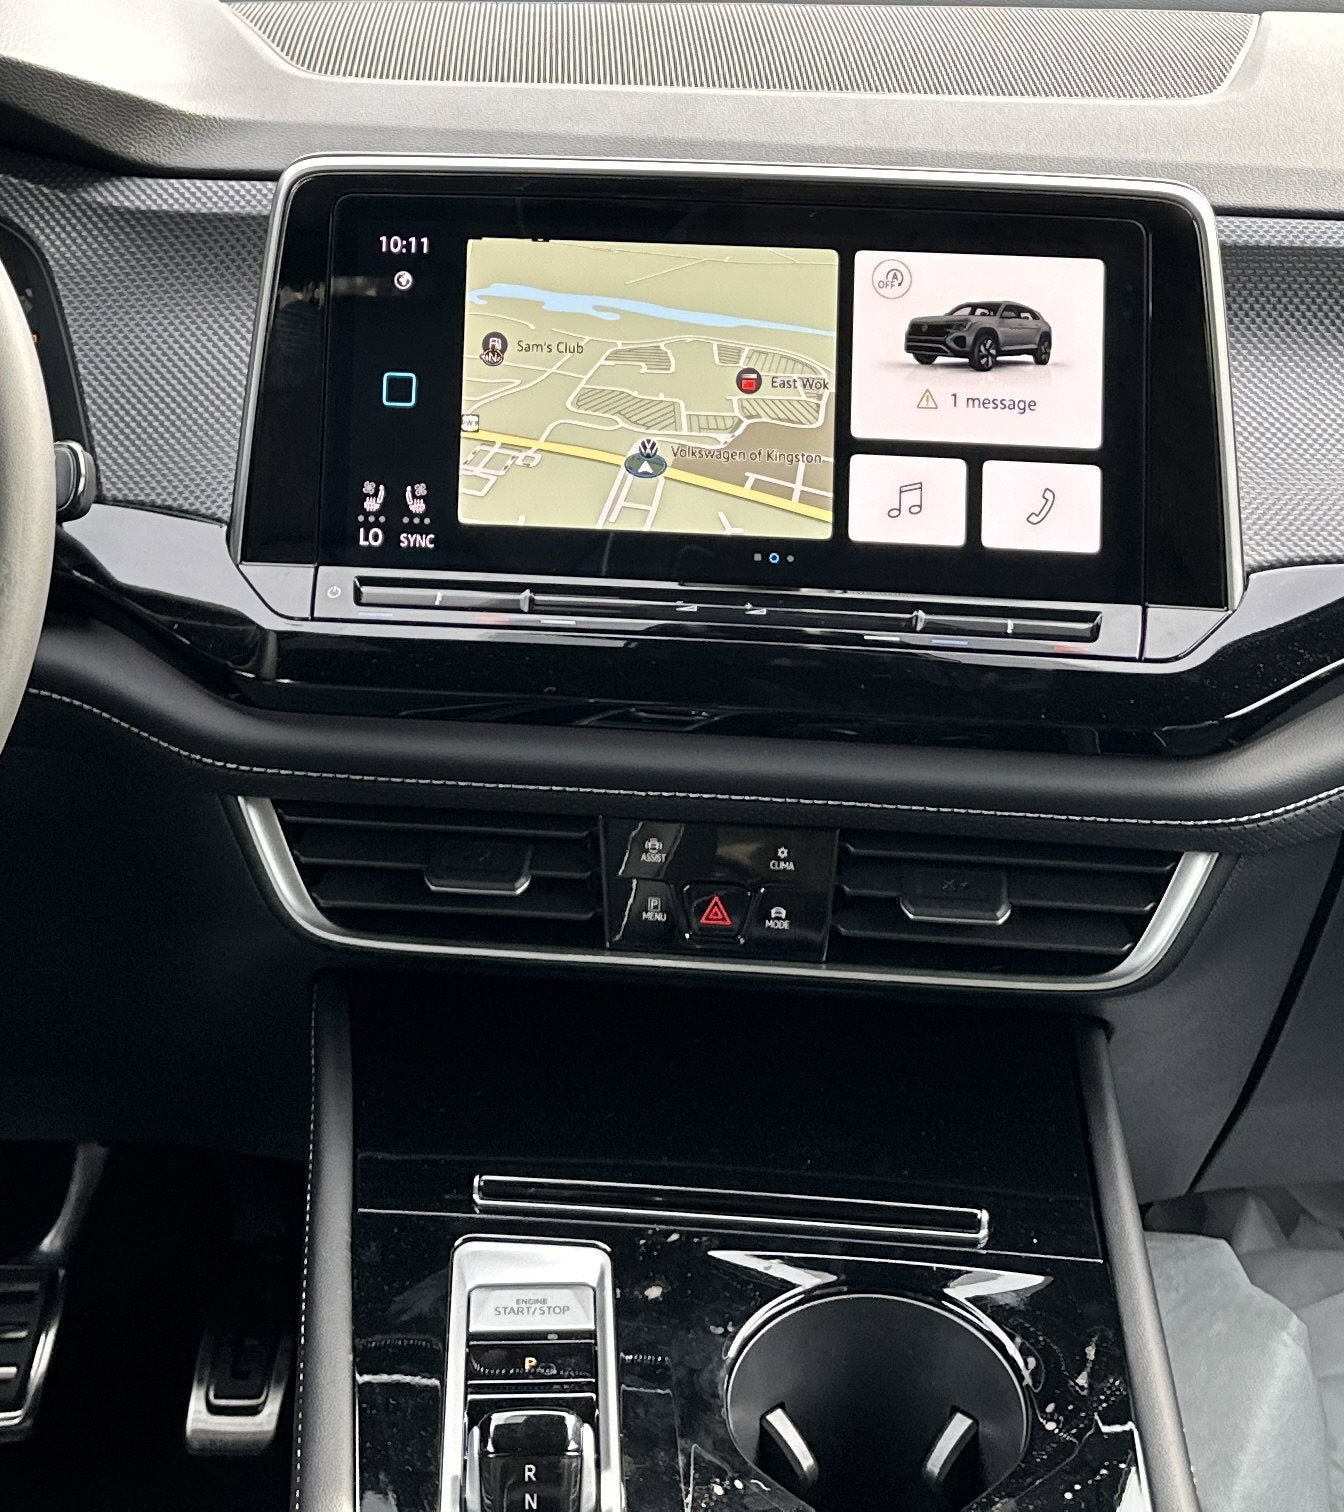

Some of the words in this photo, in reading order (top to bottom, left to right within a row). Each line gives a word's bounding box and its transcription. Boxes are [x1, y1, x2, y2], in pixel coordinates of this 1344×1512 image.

[379, 235, 430, 254] 10:11
[877, 279, 896, 289] OFF
[516, 339, 552, 354] Sam's
[556, 340, 584, 354] Club
[771, 376, 797, 389] East
[802, 377, 830, 391] Wok
[950, 392, 958, 408] 1
[966, 395, 1037, 414] message
[670, 445, 747, 462] Volkswagen
[750, 448, 763, 461] of
[766, 449, 822, 467] Kingston
[358, 527, 384, 547] LO
[399, 533, 436, 549] SYNC
[640, 851, 667, 864] ASSIST
[769, 859, 795, 872] CLIMA
[642, 911, 667, 922] MENU
[765, 918, 791, 931] MODE
[515, 1297, 548, 1306] ENGINE
[494, 1305, 571, 1317] START/STOP
[524, 1356, 538, 1372] P
[524, 1464, 537, 1482] R
[524, 1492, 538, 1511] N
